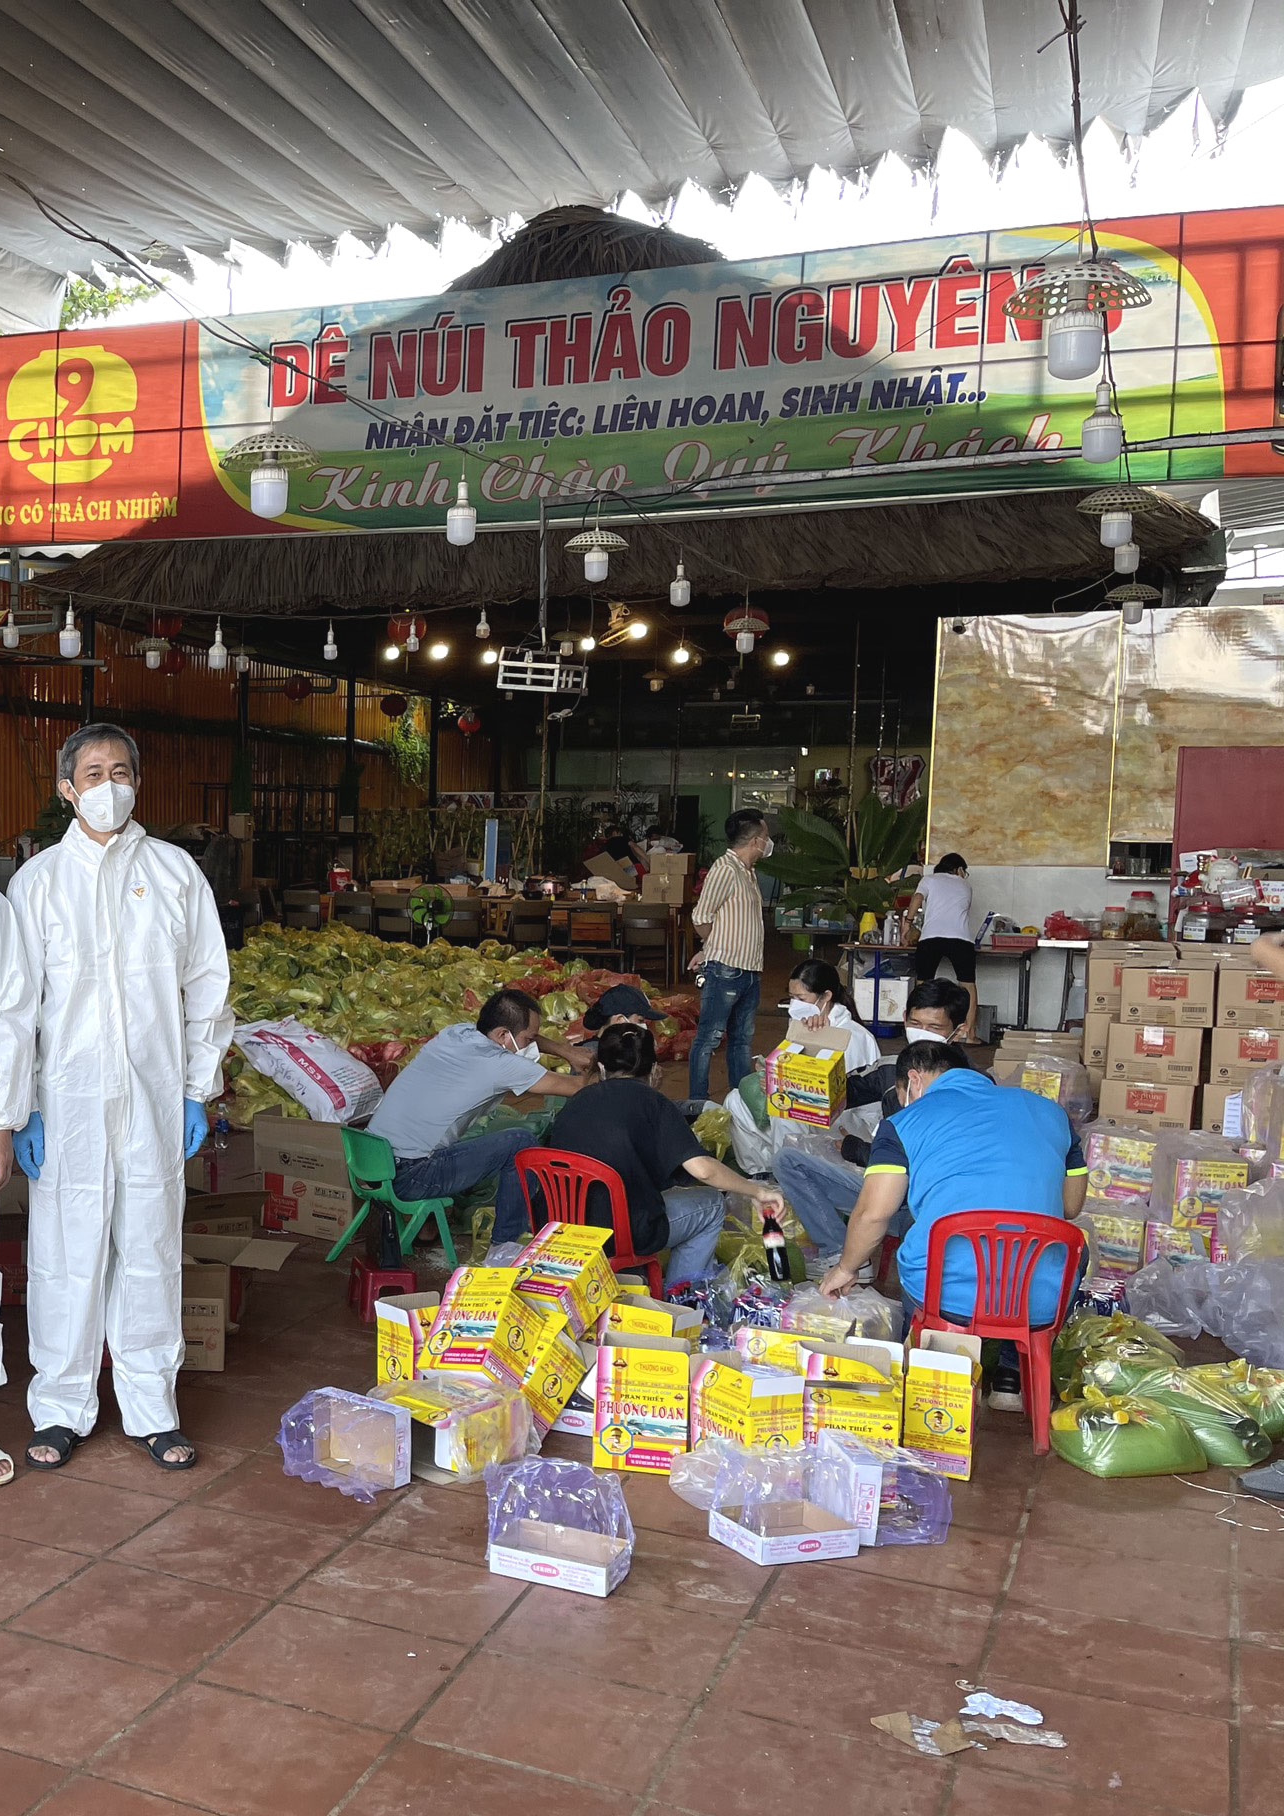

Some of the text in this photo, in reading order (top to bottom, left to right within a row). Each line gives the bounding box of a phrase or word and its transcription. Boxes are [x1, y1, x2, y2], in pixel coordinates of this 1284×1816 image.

[269, 322, 350, 409] DÊ
[368, 311, 484, 401] NÚI
[506, 283, 692, 389] THẢO
[713, 254, 1047, 370] NGUYÊN
[364, 411, 450, 459] NHẬN
[453, 404, 514, 456] ĐẶT
[517, 402, 584, 448] TIỆC:
[592, 392, 667, 435] LIÊN
[670, 387, 769, 428] HOAN,
[781, 380, 863, 418] SINH
[301, 450, 453, 512] Kính
[828, 413, 1065, 475] Khách
[19, 498, 44, 523] CÓ
[48, 496, 112, 522] TRÁCH
[115, 491, 178, 522] NHIỆM
[298, 1058, 323, 1081] MS3
[560, 1255, 587, 1267] LOAN
[474, 1310, 499, 1321] LOAN
[651, 1404, 685, 1420] LOAN
